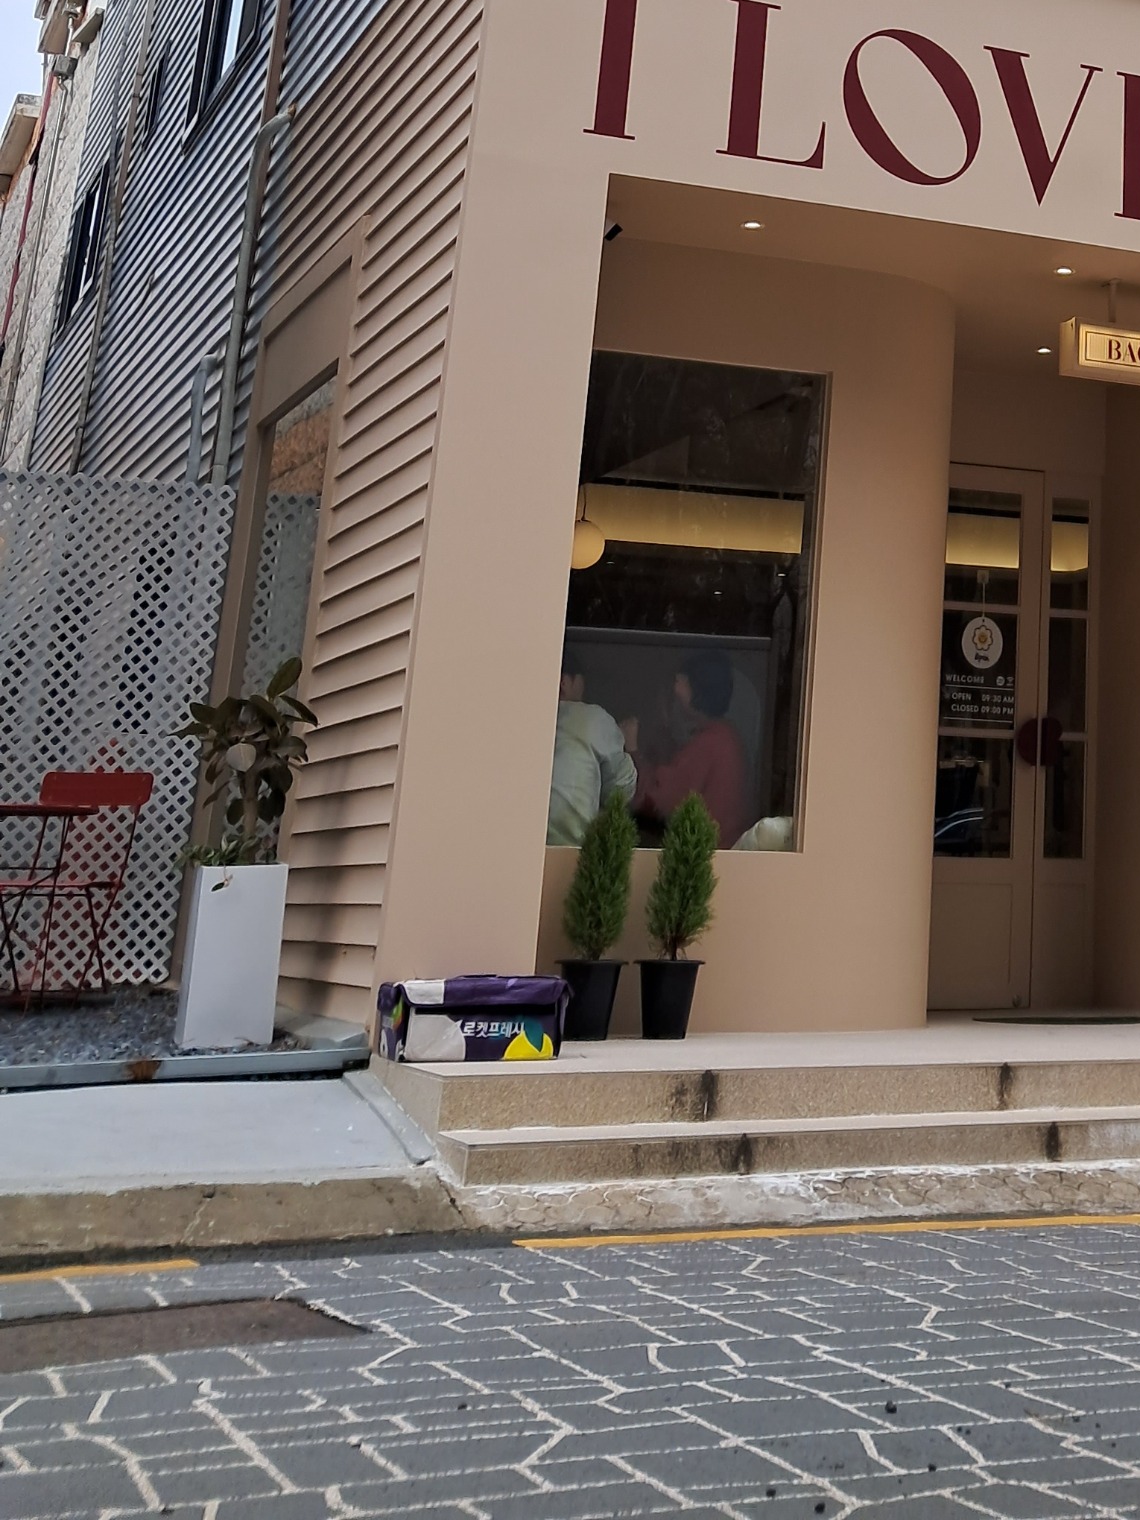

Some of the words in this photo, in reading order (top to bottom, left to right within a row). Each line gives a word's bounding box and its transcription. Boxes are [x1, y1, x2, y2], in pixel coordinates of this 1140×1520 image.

[945, 673, 985, 684] WELCOME
[951, 691, 972, 701] OPEN
[1002, 696, 1015, 704] AM
[951, 703, 979, 713] CLOSED
[1002, 707, 1014, 715] PM
[462, 1019, 525, 1039] 로켓프레시
